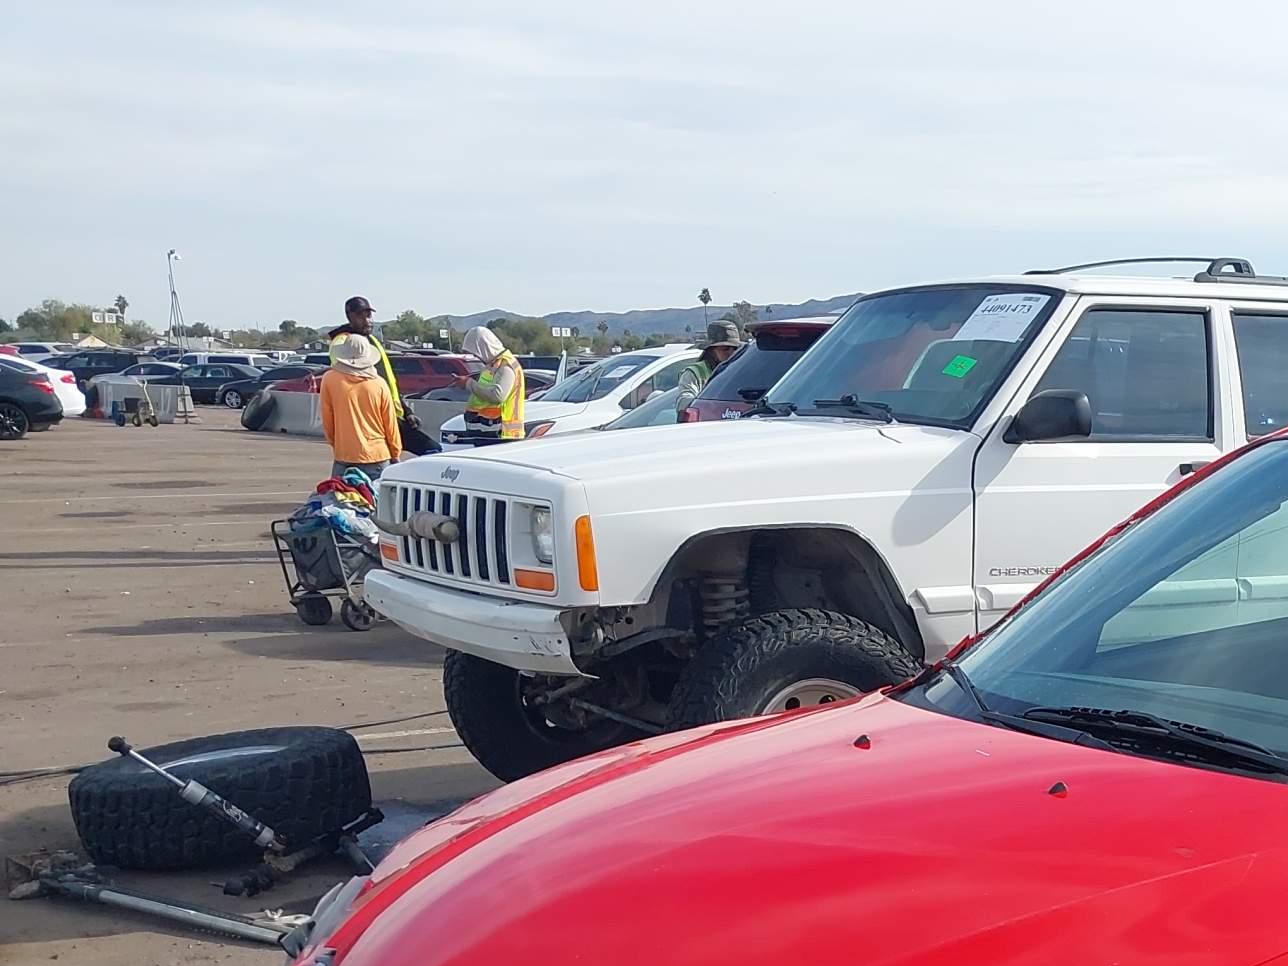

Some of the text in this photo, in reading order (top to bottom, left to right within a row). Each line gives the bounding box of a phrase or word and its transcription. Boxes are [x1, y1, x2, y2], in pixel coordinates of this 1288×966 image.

[981, 304, 1033, 314] 44091473
[722, 408, 741, 420] Jeep
[440, 465, 460, 483] Jeep
